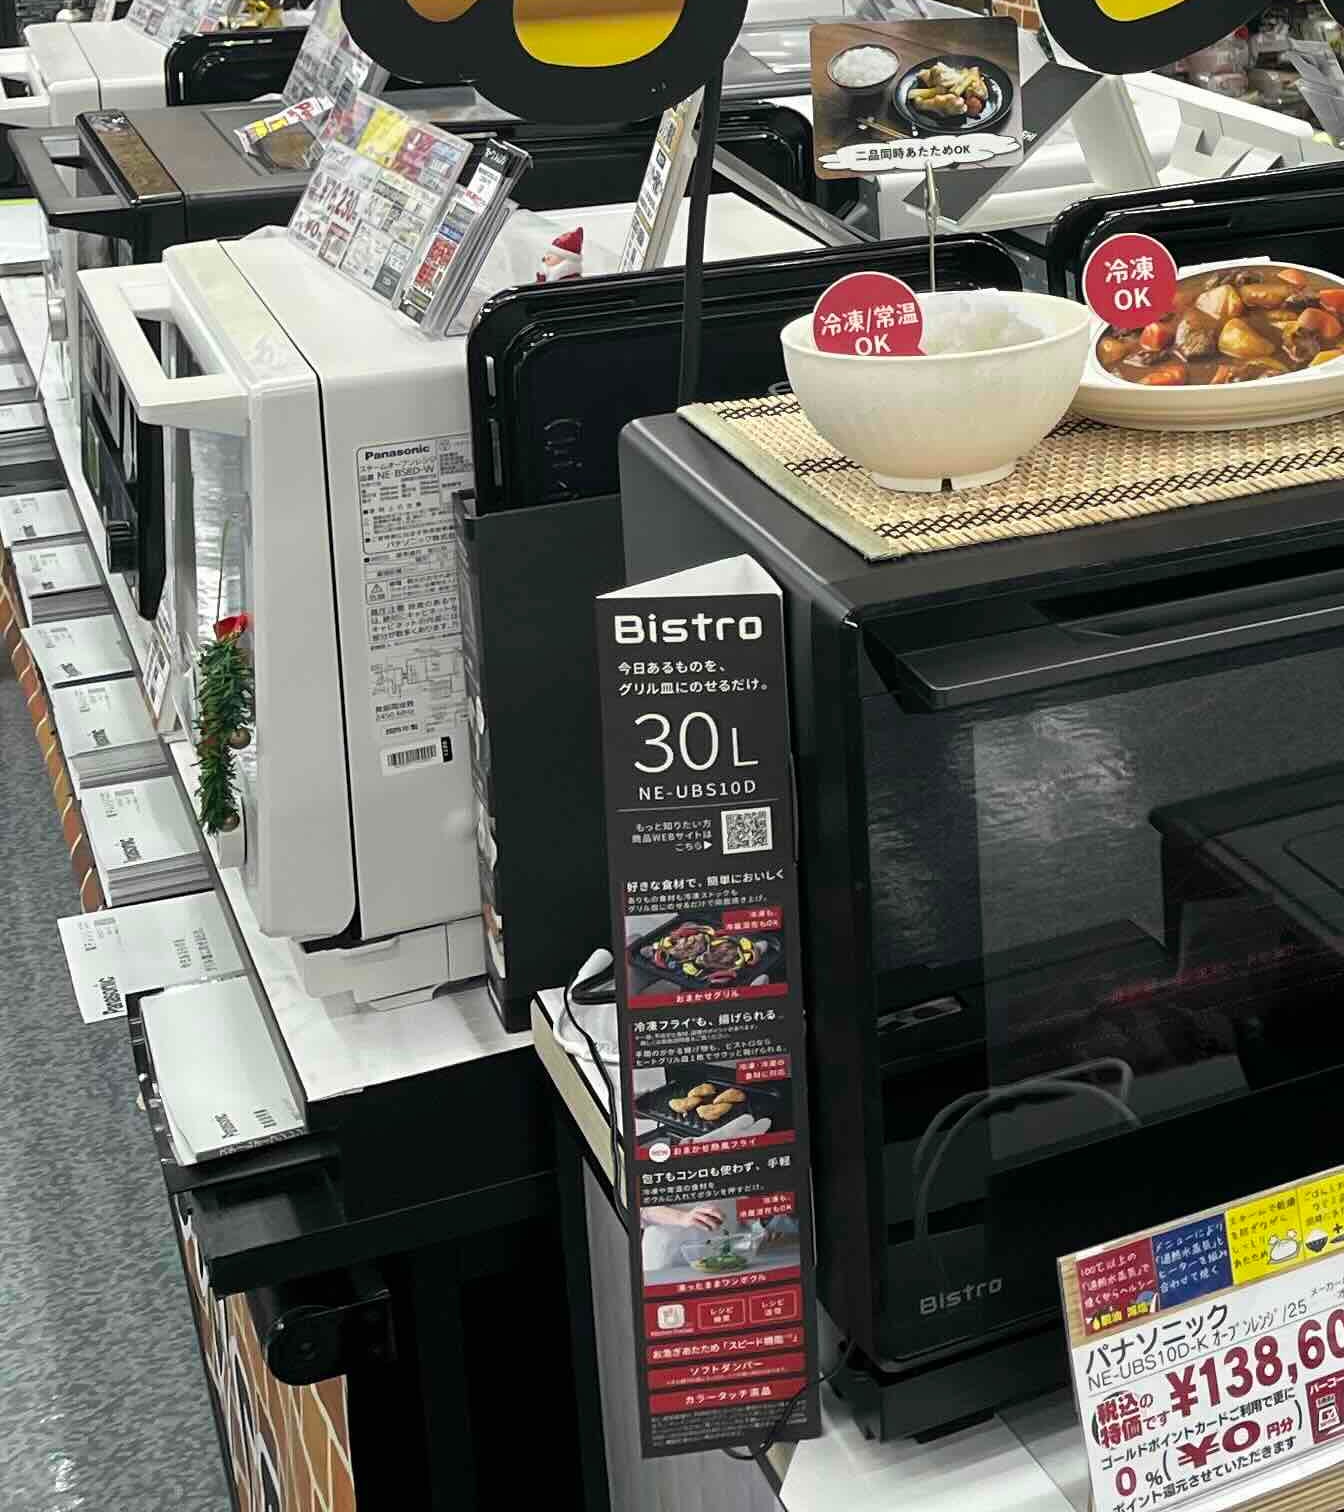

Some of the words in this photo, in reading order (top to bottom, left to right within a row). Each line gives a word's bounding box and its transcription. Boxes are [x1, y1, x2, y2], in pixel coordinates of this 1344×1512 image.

[854, 142, 972, 163] 二品同時あたためOK
[1104, 255, 1155, 283] 冷凍
[1113, 287, 1152, 312] OK
[819, 302, 919, 337] 冷凍/常温
[855, 335, 892, 356] OK
[365, 445, 430, 461] Panasonic
[614, 613, 763, 644] Bistro
[618, 659, 726, 675] 今日あるものを、
[618, 678, 768, 696] グリル皿にのせるだけ。
[634, 711, 759, 773] 30L
[638, 779, 757, 801] NE-UBS10D
[626, 869, 785, 893] 好きな食材で、簡単においしく
[919, 1277, 1003, 1316] Bistro
[1085, 1304, 1229, 1375] パナソニック
[1088, 1336, 1209, 1390] NE-UBS10D-K
[1100, 1410, 1171, 1449] 特価です
[1101, 1387, 1298, 1470] ゴールドポイントカードご利用で更に
[1111, 1435, 1298, 1512] ポイント還元させていただきます
